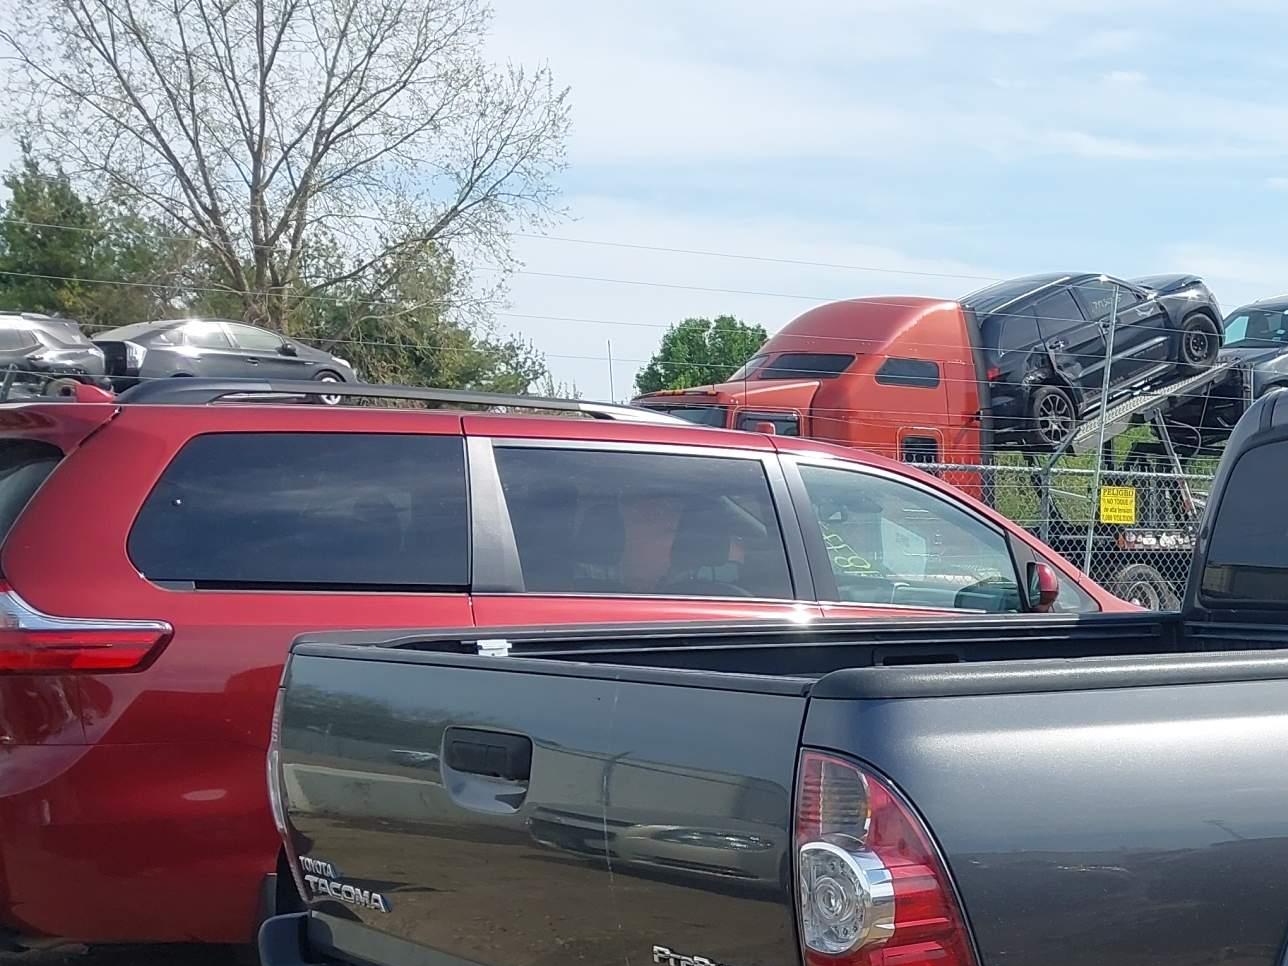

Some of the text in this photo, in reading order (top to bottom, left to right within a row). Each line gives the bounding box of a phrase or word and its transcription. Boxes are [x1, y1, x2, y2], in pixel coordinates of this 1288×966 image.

[1103, 488, 1134, 497] PELIGRO
[299, 855, 337, 879] TOYOTA
[304, 874, 390, 913] TACOMA
